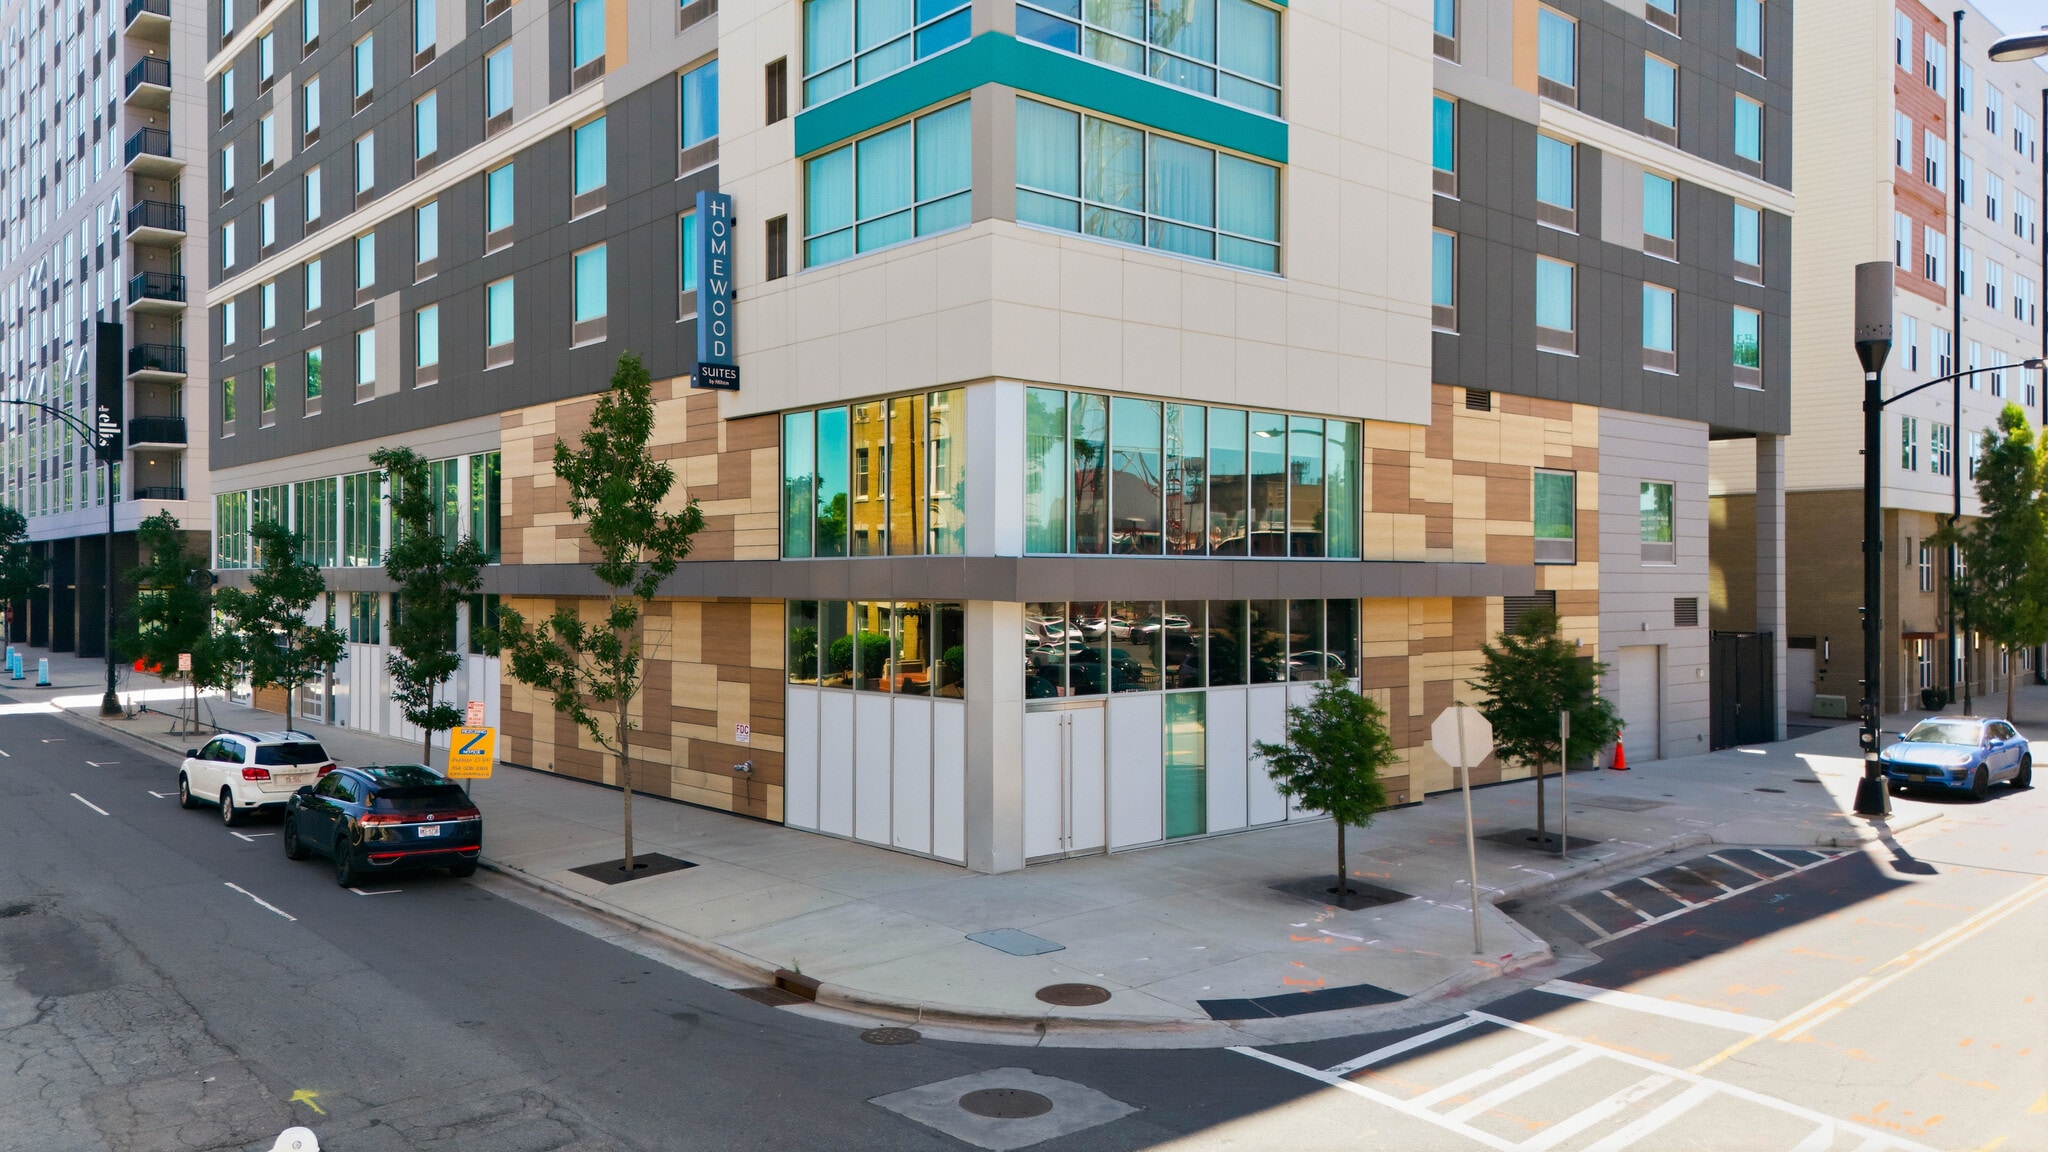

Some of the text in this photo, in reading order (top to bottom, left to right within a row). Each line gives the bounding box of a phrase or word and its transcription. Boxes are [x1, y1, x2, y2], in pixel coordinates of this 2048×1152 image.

[710, 200, 728, 357] HOMEWOOD
[702, 366, 737, 379] SUITES
[737, 724, 749, 734] FDC
